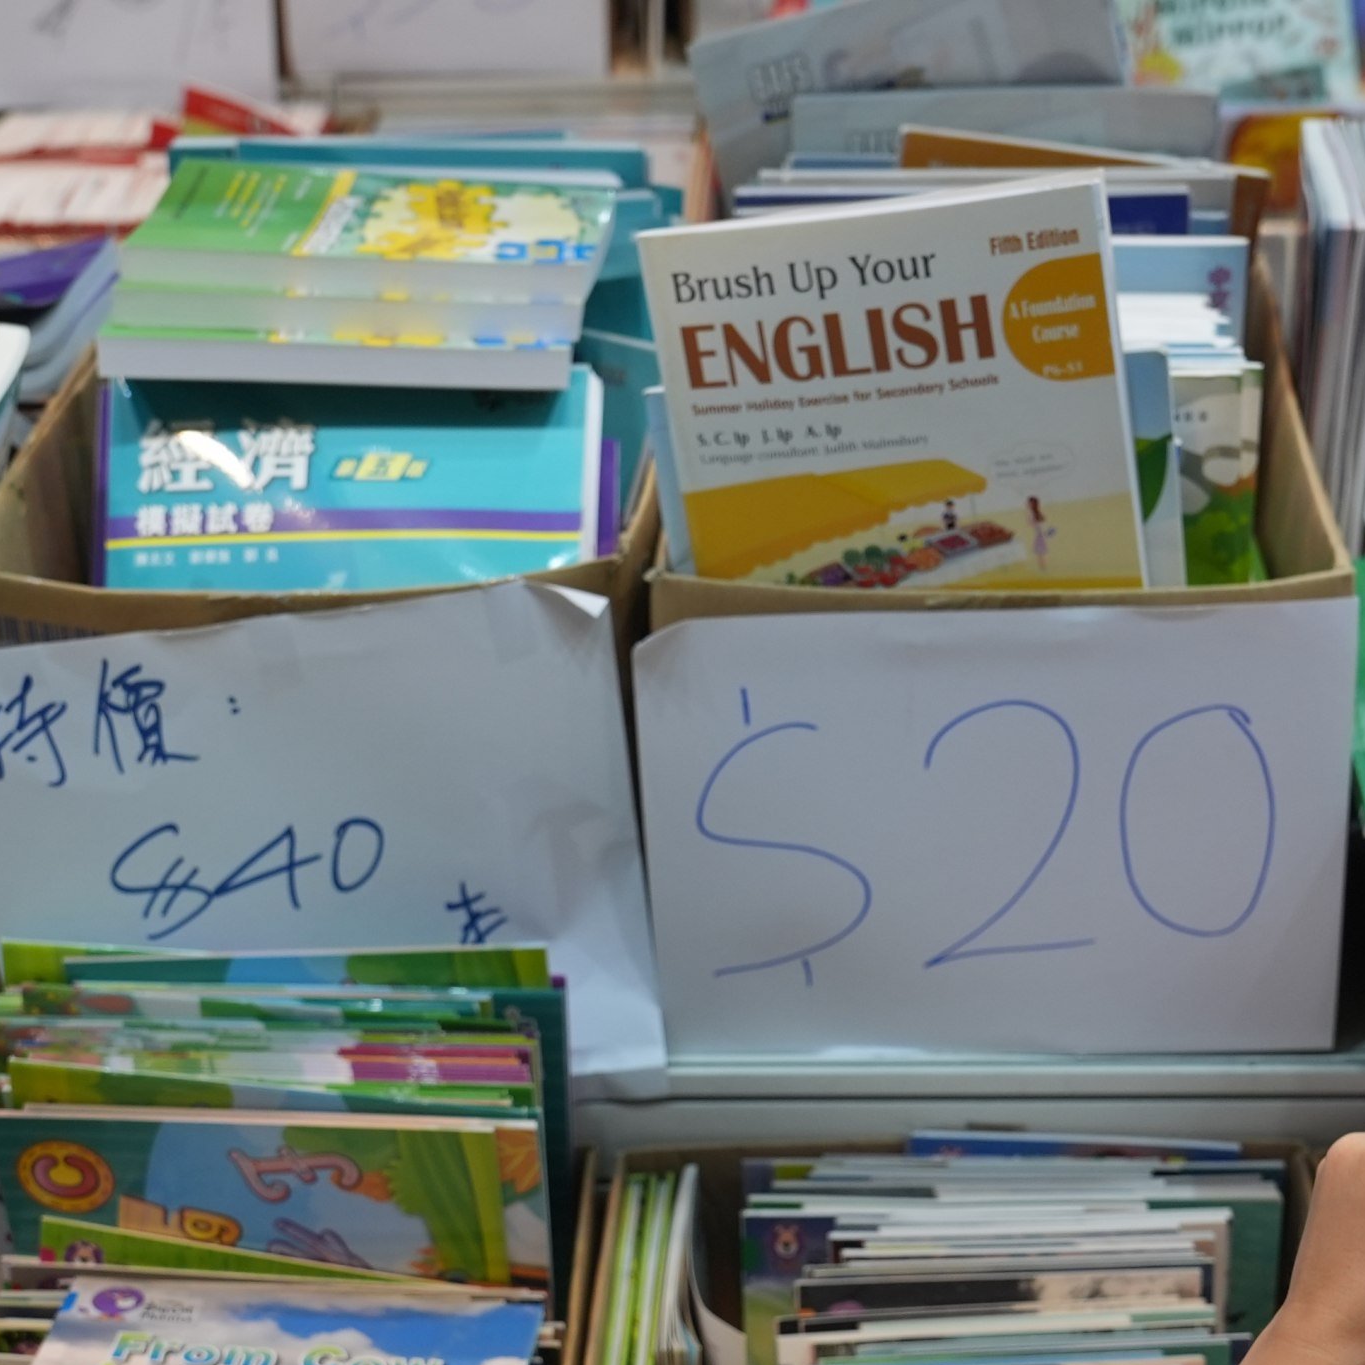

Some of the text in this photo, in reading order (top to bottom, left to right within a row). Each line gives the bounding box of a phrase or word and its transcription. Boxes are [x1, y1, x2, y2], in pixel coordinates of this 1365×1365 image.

[989, 227, 1080, 257] Fifth Edition
[671, 251, 937, 304] Brush Up Your
[1020, 291, 1097, 320] Foundation
[679, 293, 997, 392] ENGLISH
[1031, 321, 1080, 345] Course
[691, 398, 743, 417] Summer
[852, 388, 873, 403] for
[875, 378, 946, 401] Secondary
[947, 372, 1000, 392] Schools
[696, 687, 1275, 987] $20
[110, 818, 385, 941] $40
